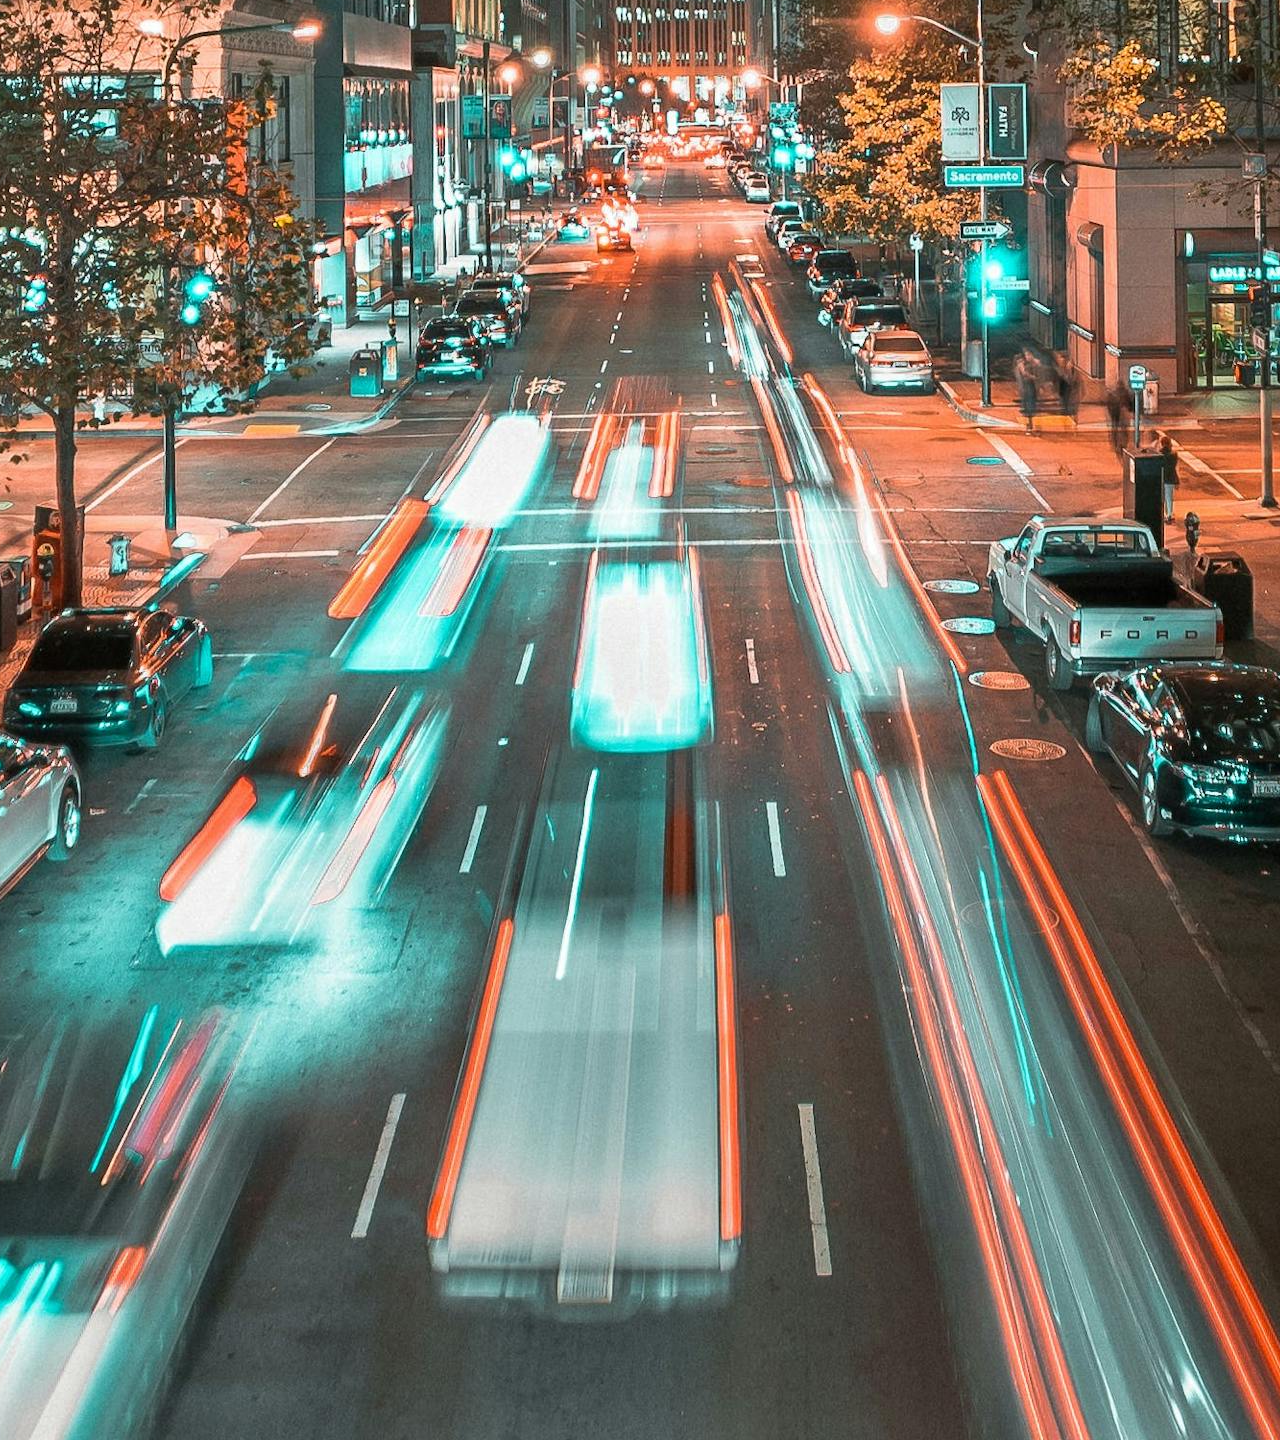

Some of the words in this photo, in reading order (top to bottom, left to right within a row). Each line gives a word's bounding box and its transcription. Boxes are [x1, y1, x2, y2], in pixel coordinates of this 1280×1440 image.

[999, 106, 1008, 137] FAITH
[950, 171, 1019, 182] Sacramento
[1100, 630, 1198, 639] FORD
